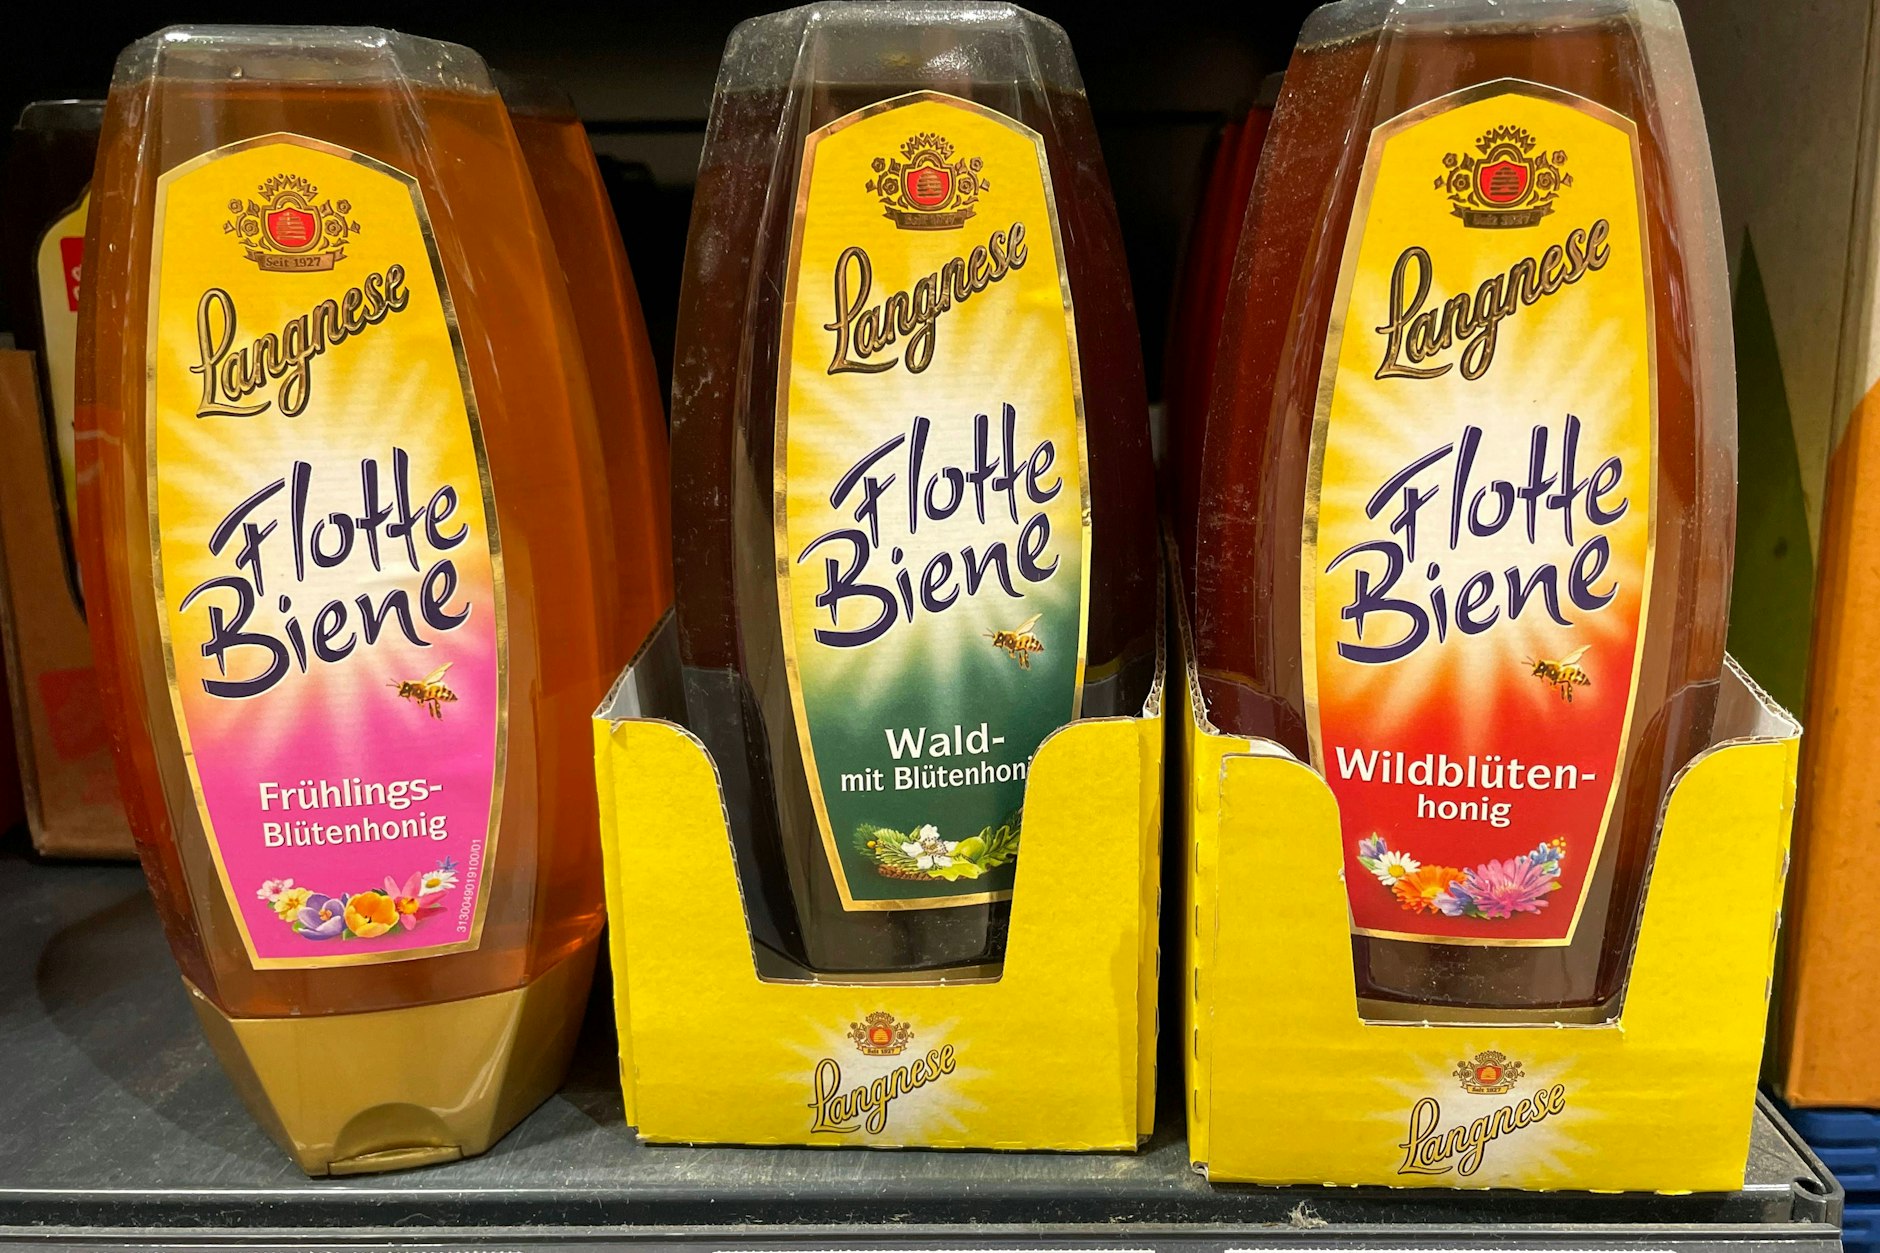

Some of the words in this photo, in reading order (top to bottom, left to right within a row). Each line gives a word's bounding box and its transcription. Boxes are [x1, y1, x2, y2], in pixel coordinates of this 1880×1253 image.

[265, 257, 288, 268] Seit
[293, 256, 321, 268] 1927
[823, 221, 1029, 376] Langnese
[1375, 218, 1611, 380] Langnese
[189, 263, 410, 418] Langnese
[208, 446, 469, 597] Flotte
[829, 402, 1063, 548] Flotte
[1365, 413, 1629, 562] Flotte
[797, 513, 1060, 649] Biene
[1325, 534, 1618, 665] Biene
[179, 558, 472, 700] Biene
[840, 769, 884, 793] mit
[893, 755, 1033, 792] Blütenhoni
[884, 722, 1006, 759] Wald-
[1334, 746, 1597, 791] Wildblüten-
[259, 777, 443, 811] Frühlings-
[262, 812, 448, 848] Blütenhonig
[1417, 793, 1513, 828] honig
[456, 839, 481, 933] 3130049019100/01
[808, 1044, 956, 1135] Langnese
[1397, 1083, 1566, 1177] Langnese
